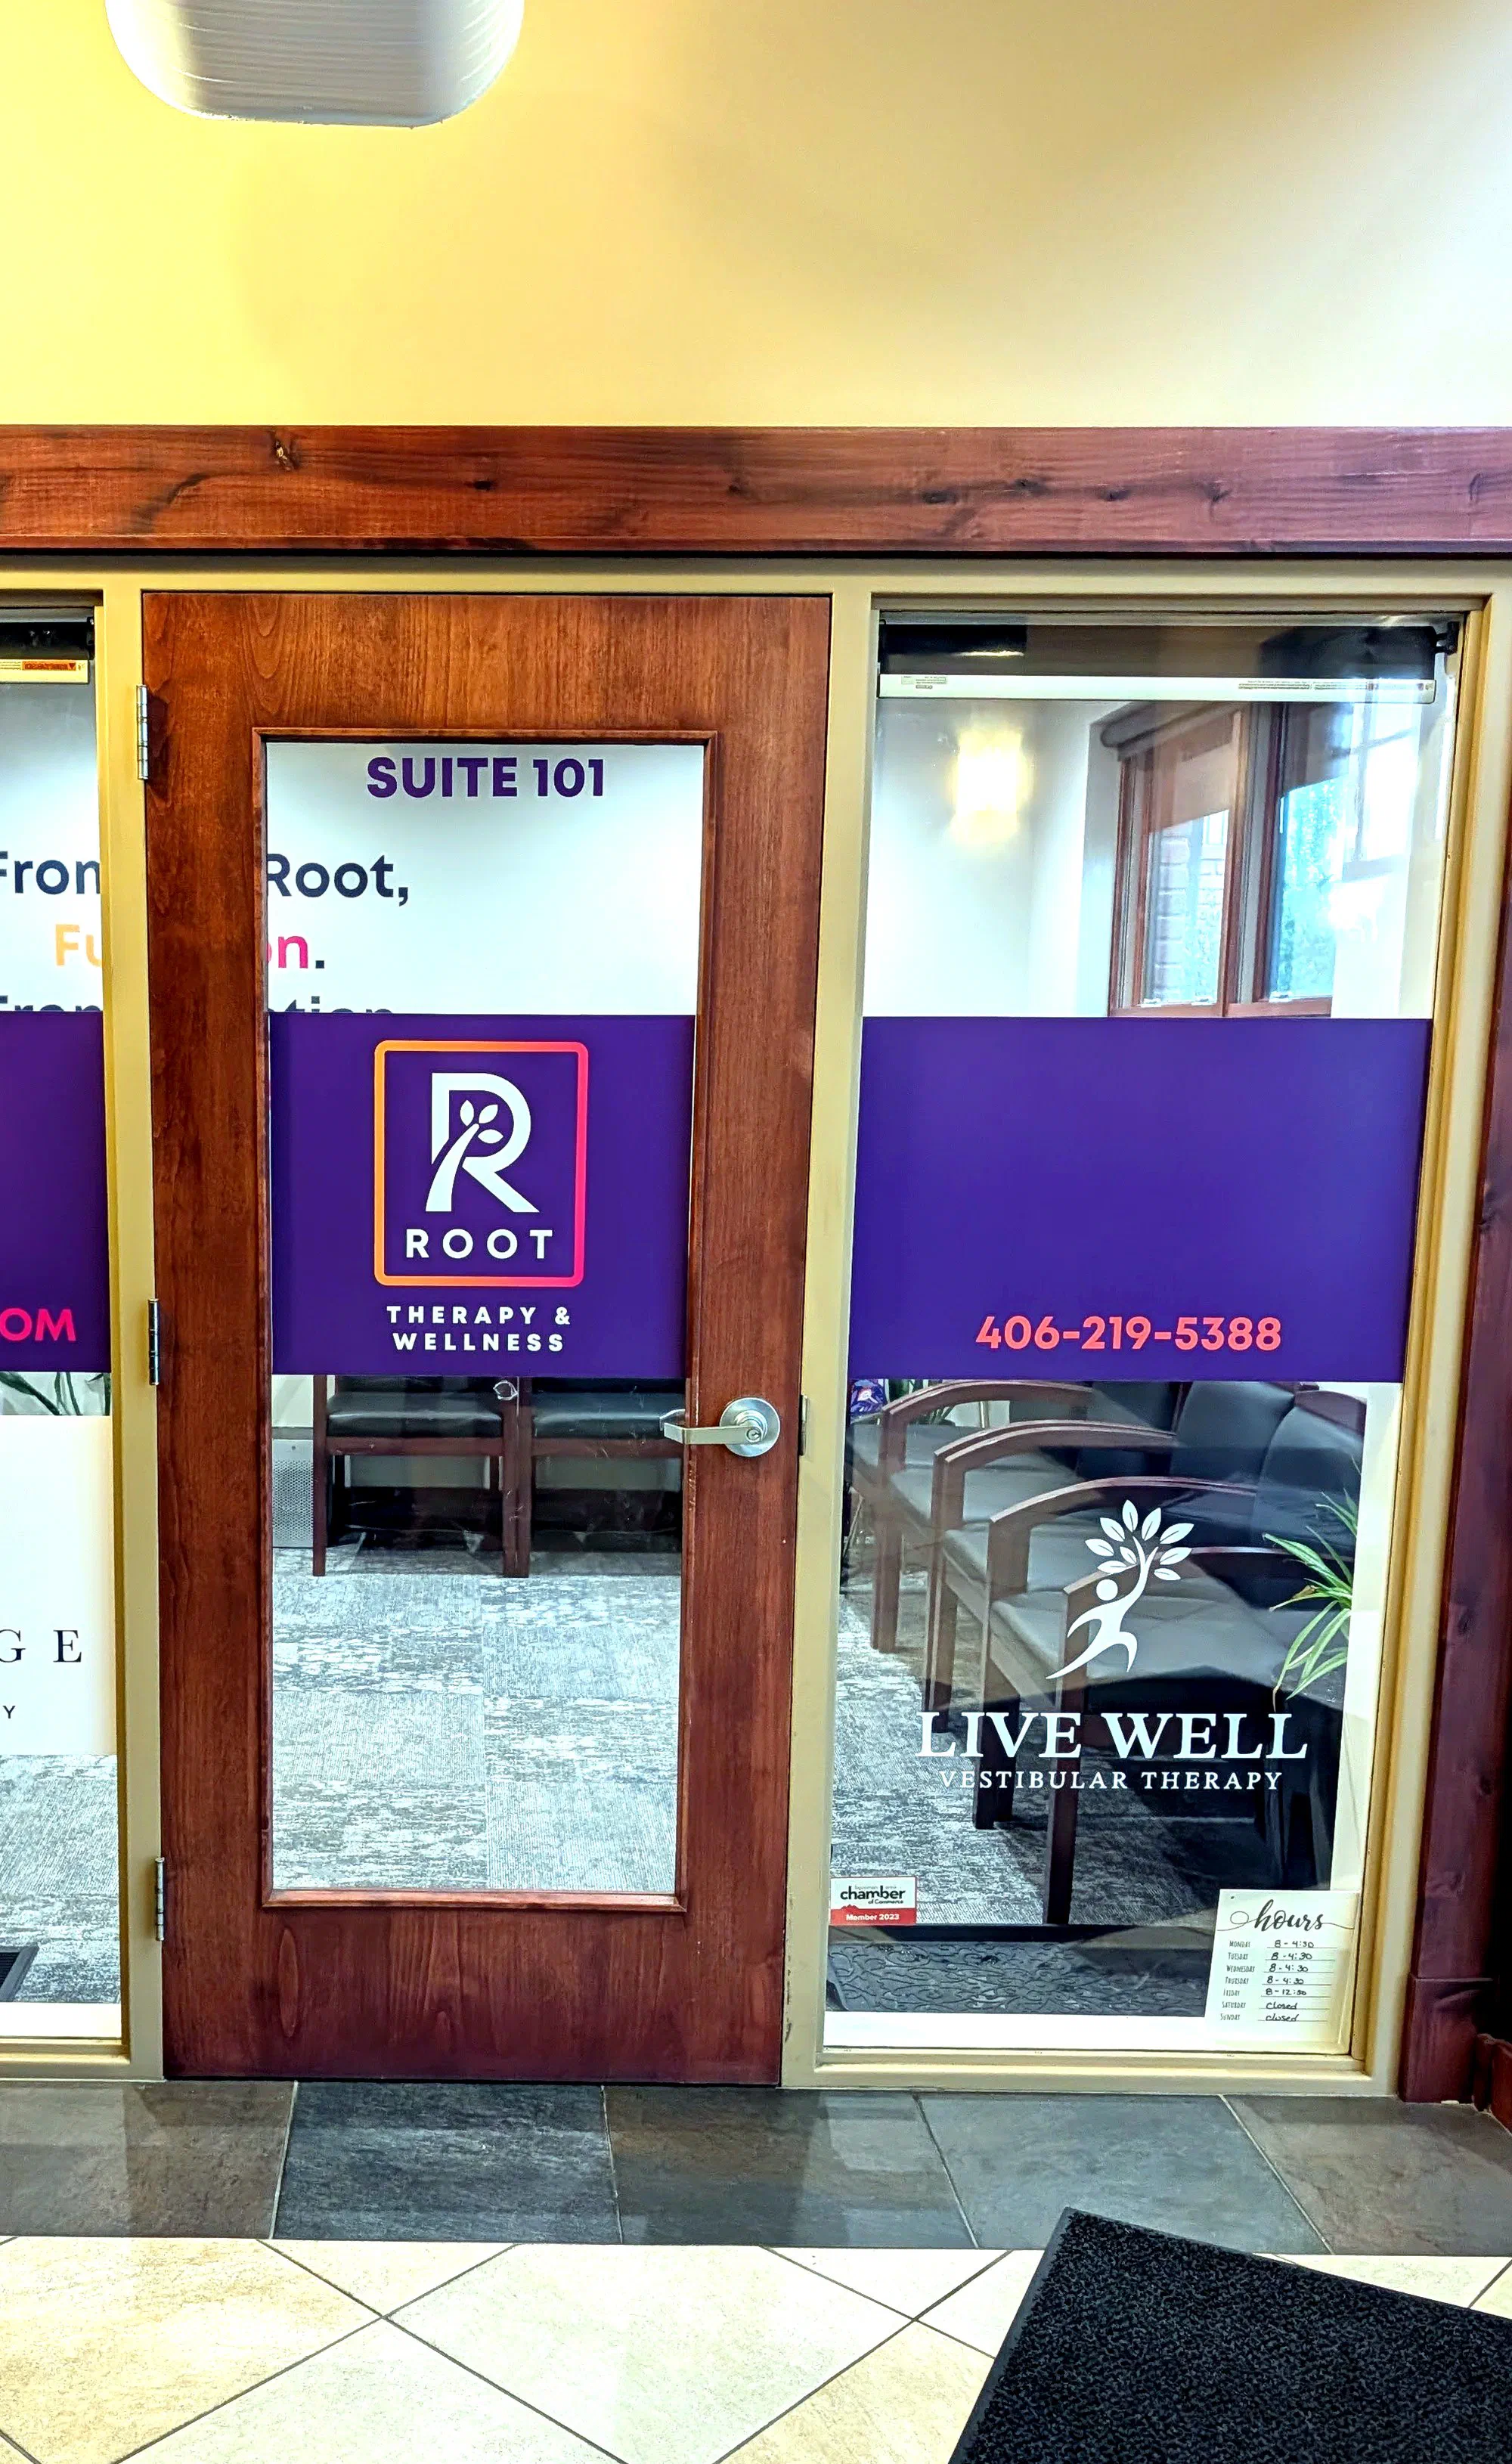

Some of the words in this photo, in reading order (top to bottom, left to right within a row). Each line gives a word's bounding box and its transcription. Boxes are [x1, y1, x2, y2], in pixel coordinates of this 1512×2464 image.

[367, 758, 518, 798] SUITE
[533, 758, 605, 798] 101
[0, 851, 101, 895] rom
[267, 853, 409, 907] Root,
[406, 1228, 553, 1260] ROOT
[386, 1305, 537, 1325] THERAPY
[554, 1306, 571, 1325] &
[392, 1332, 564, 1353] WELLNESS
[975, 1315, 1282, 1351] 406-219-5388
[915, 1710, 1082, 1759] LIVE
[1101, 1712, 1308, 1759] WELL
[939, 1770, 1129, 1790] VESTIBULAR
[1140, 1771, 1282, 1790] THERAPY
[840, 1885, 906, 1900] chamber
[1232, 1898, 1331, 1932] hours
